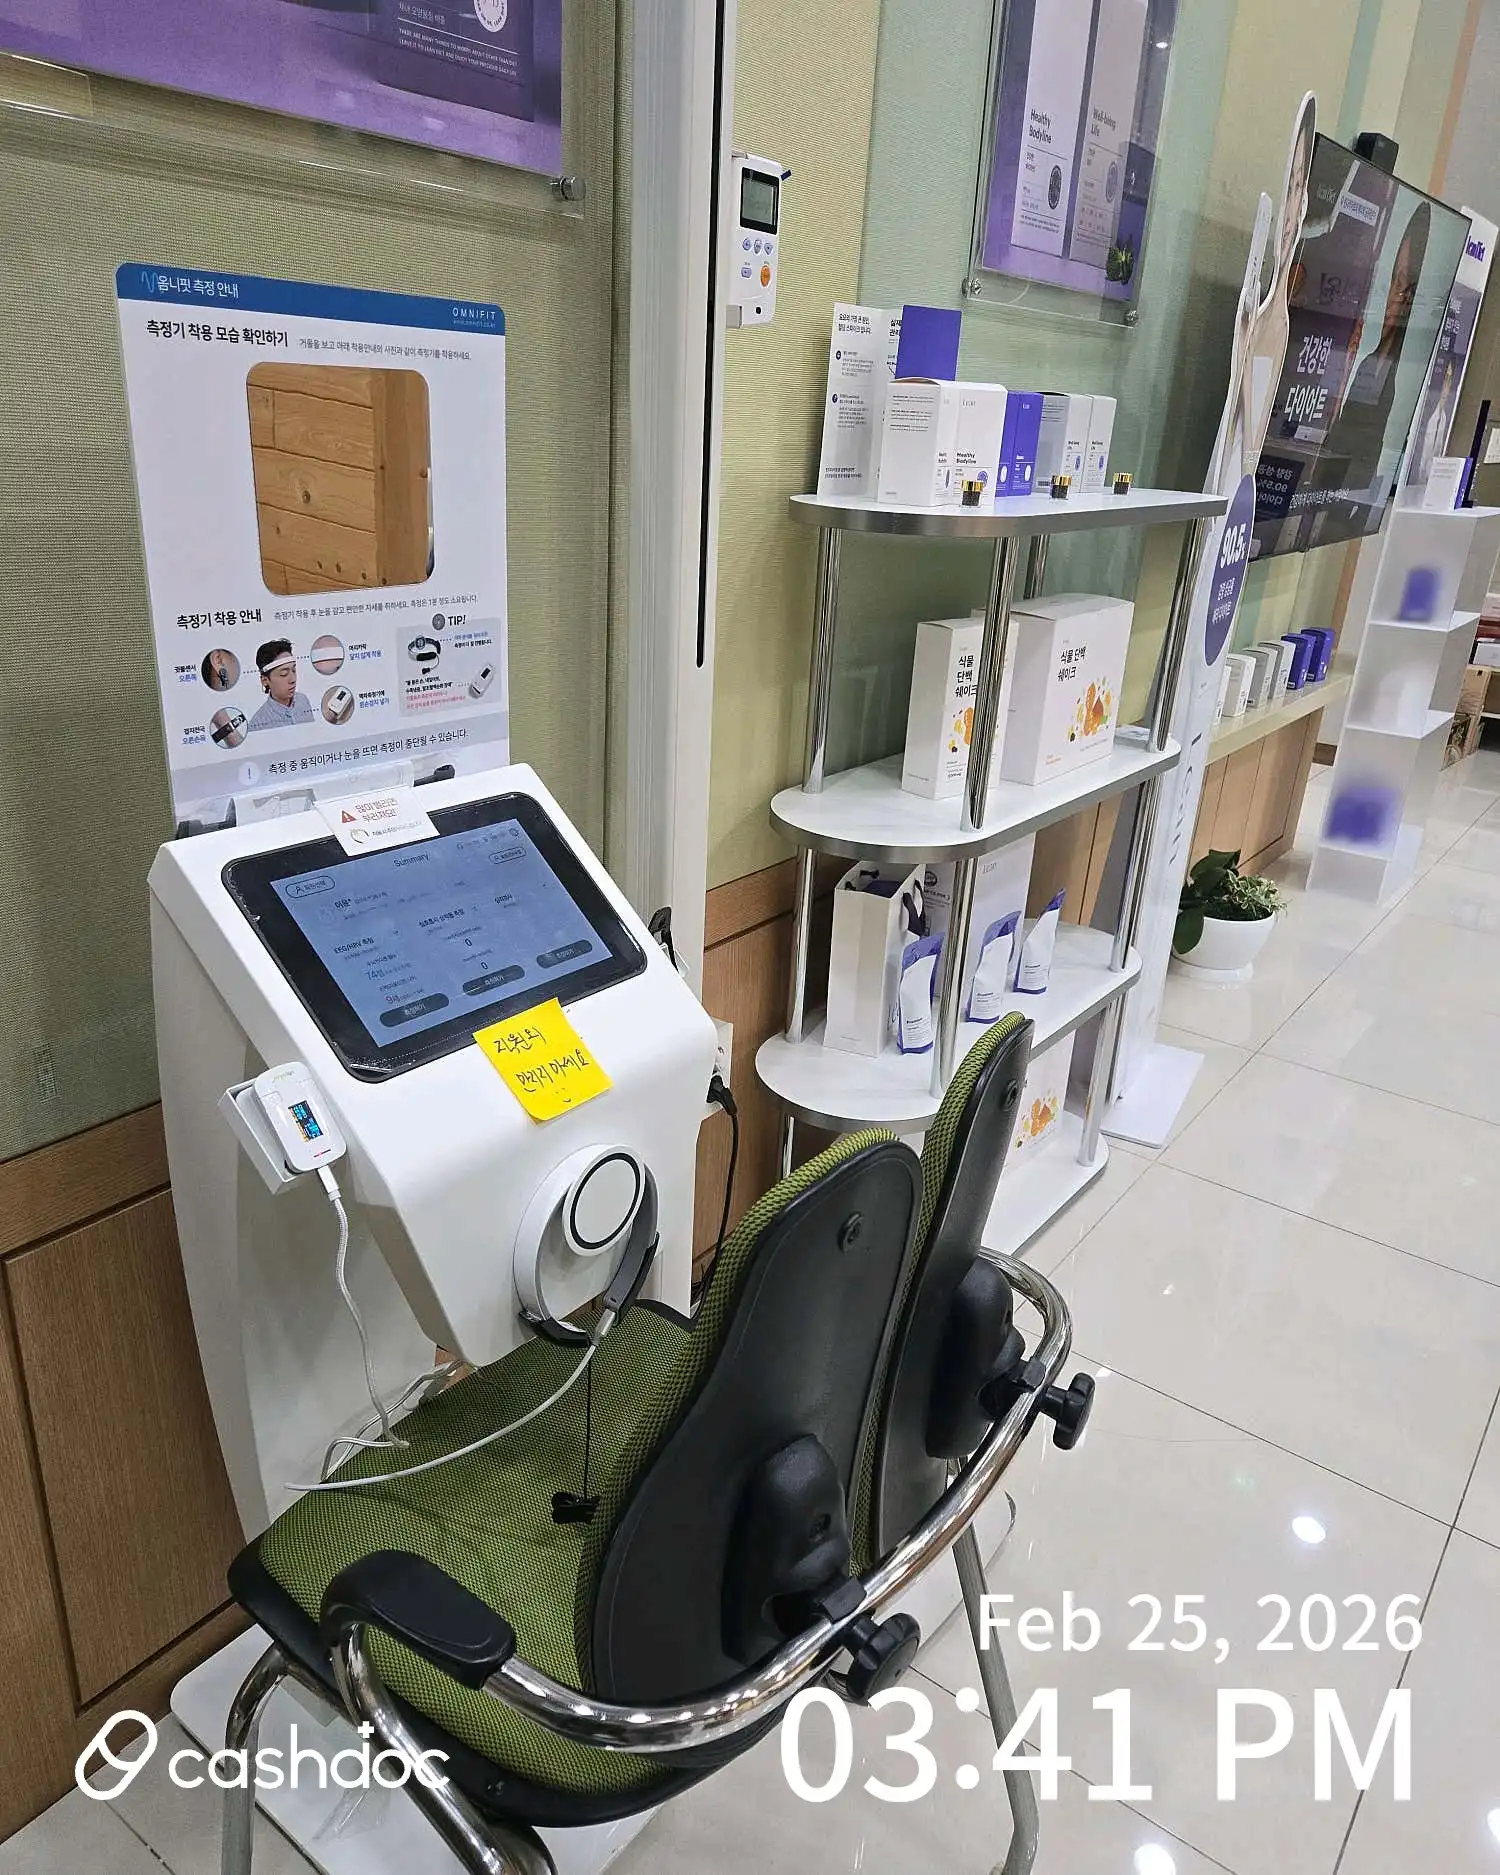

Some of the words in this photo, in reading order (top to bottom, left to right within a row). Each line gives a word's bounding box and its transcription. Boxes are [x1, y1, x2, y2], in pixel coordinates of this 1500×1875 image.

[1030, 109, 1051, 129] Healthy
[1029, 125, 1052, 144] Bodyline
[158, 275, 191, 293] 옴니핏
[193, 279, 215, 296] 측정
[217, 282, 239, 299] 안내
[452, 307, 496, 320] OMNIFIT
[147, 320, 186, 339] 측정기
[188, 322, 213, 341] 착용
[216, 326, 240, 344] 모습
[242, 328, 288, 347] 확인하기
[300, 338, 321, 349] 거울을
[322, 340, 335, 350] 보고
[385, 345, 403, 356] 사진과
[417, 348, 440, 359] 측정기를
[1297, 335, 1333, 375] 건강한
[1284, 384, 1329, 422] 다이어트
[177, 613, 212, 629] 측정기
[214, 611, 237, 626] 착용
[239, 608, 261, 624] 안내
[447, 615, 466, 626] TIP!
[958, 654, 974, 668] 식물
[1060, 648, 1074, 664] 식물
[1074, 646, 1087, 662] 단백
[957, 670, 973, 684] 단백
[1058, 666, 1077, 682] 쉐이크
[954, 684, 978, 698] 쉐이크
[269, 763, 286, 774] 측정
[289, 760, 298, 771] 중
[300, 752, 342, 770] 움직이거나
[344, 749, 361, 761] 눈을
[362, 745, 378, 757] 뜨면
[380, 740, 403, 753] 측정이
[429, 733, 437, 744] 수
[438, 729, 469, 743] 있습니다.
[394, 853, 430, 867] Summary
[465, 938, 473, 947] 0
[480, 961, 488, 970] 0
[549, 1048, 590, 1077] 마세요
